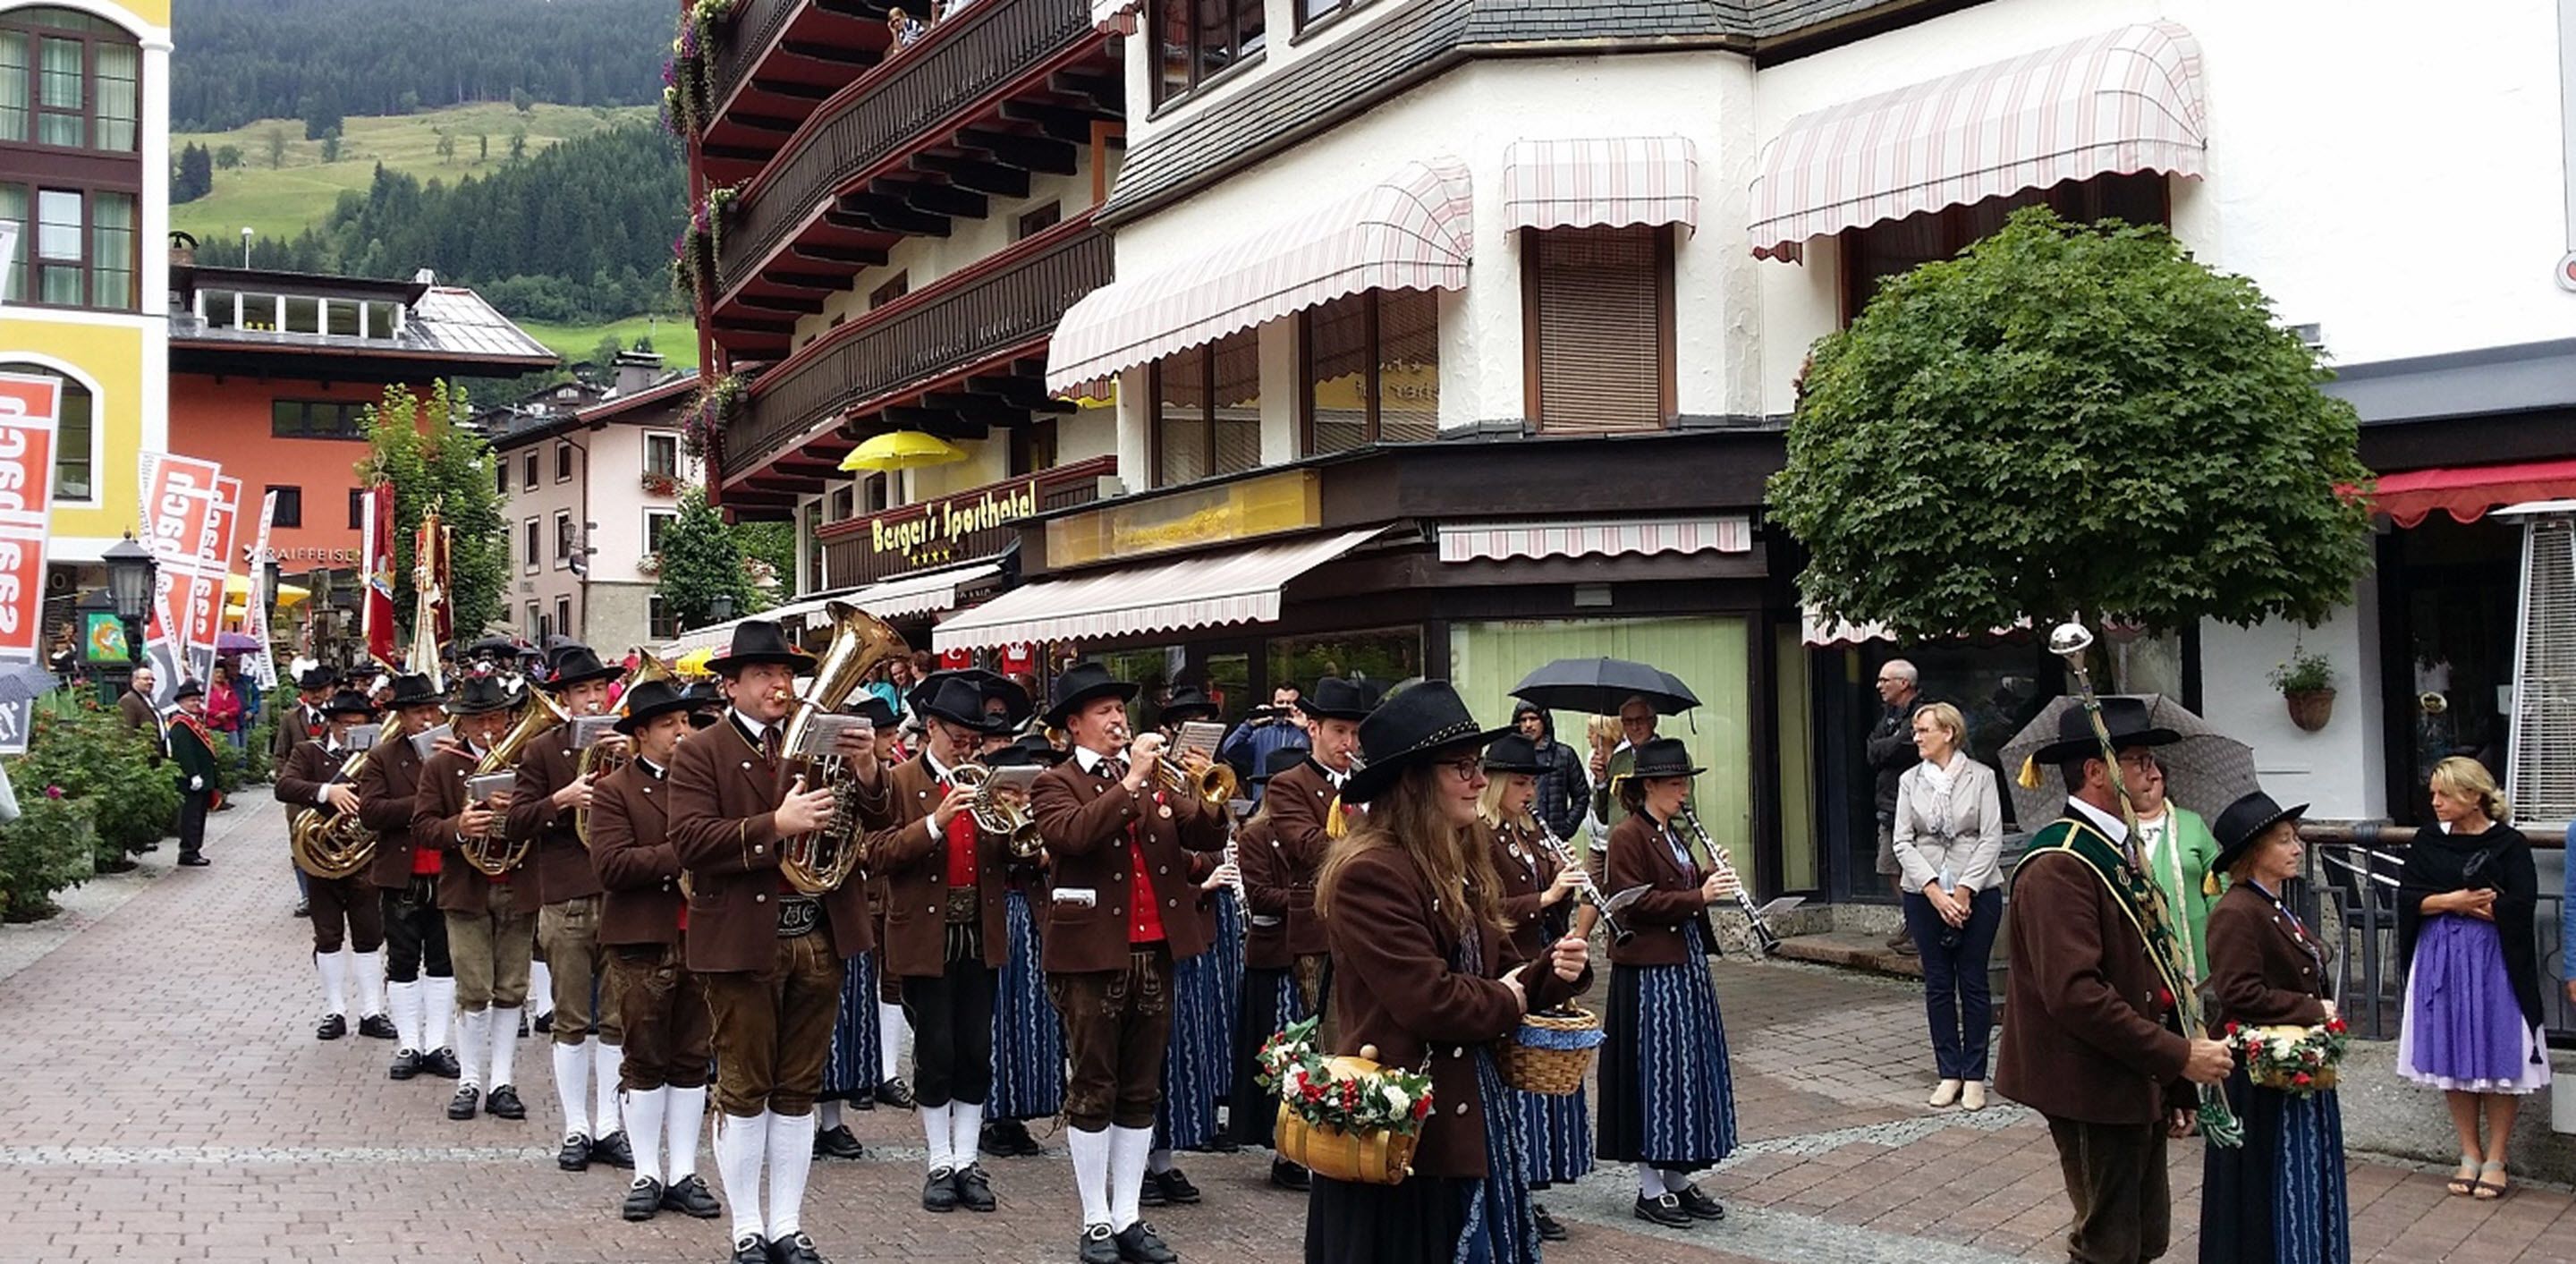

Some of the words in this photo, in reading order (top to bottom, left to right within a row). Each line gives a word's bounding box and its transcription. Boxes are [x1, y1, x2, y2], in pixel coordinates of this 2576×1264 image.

[872, 503, 937, 556] Berger's
[944, 480, 1037, 544] Sporthotel
[266, 547, 361, 562] RAIFFEISE
